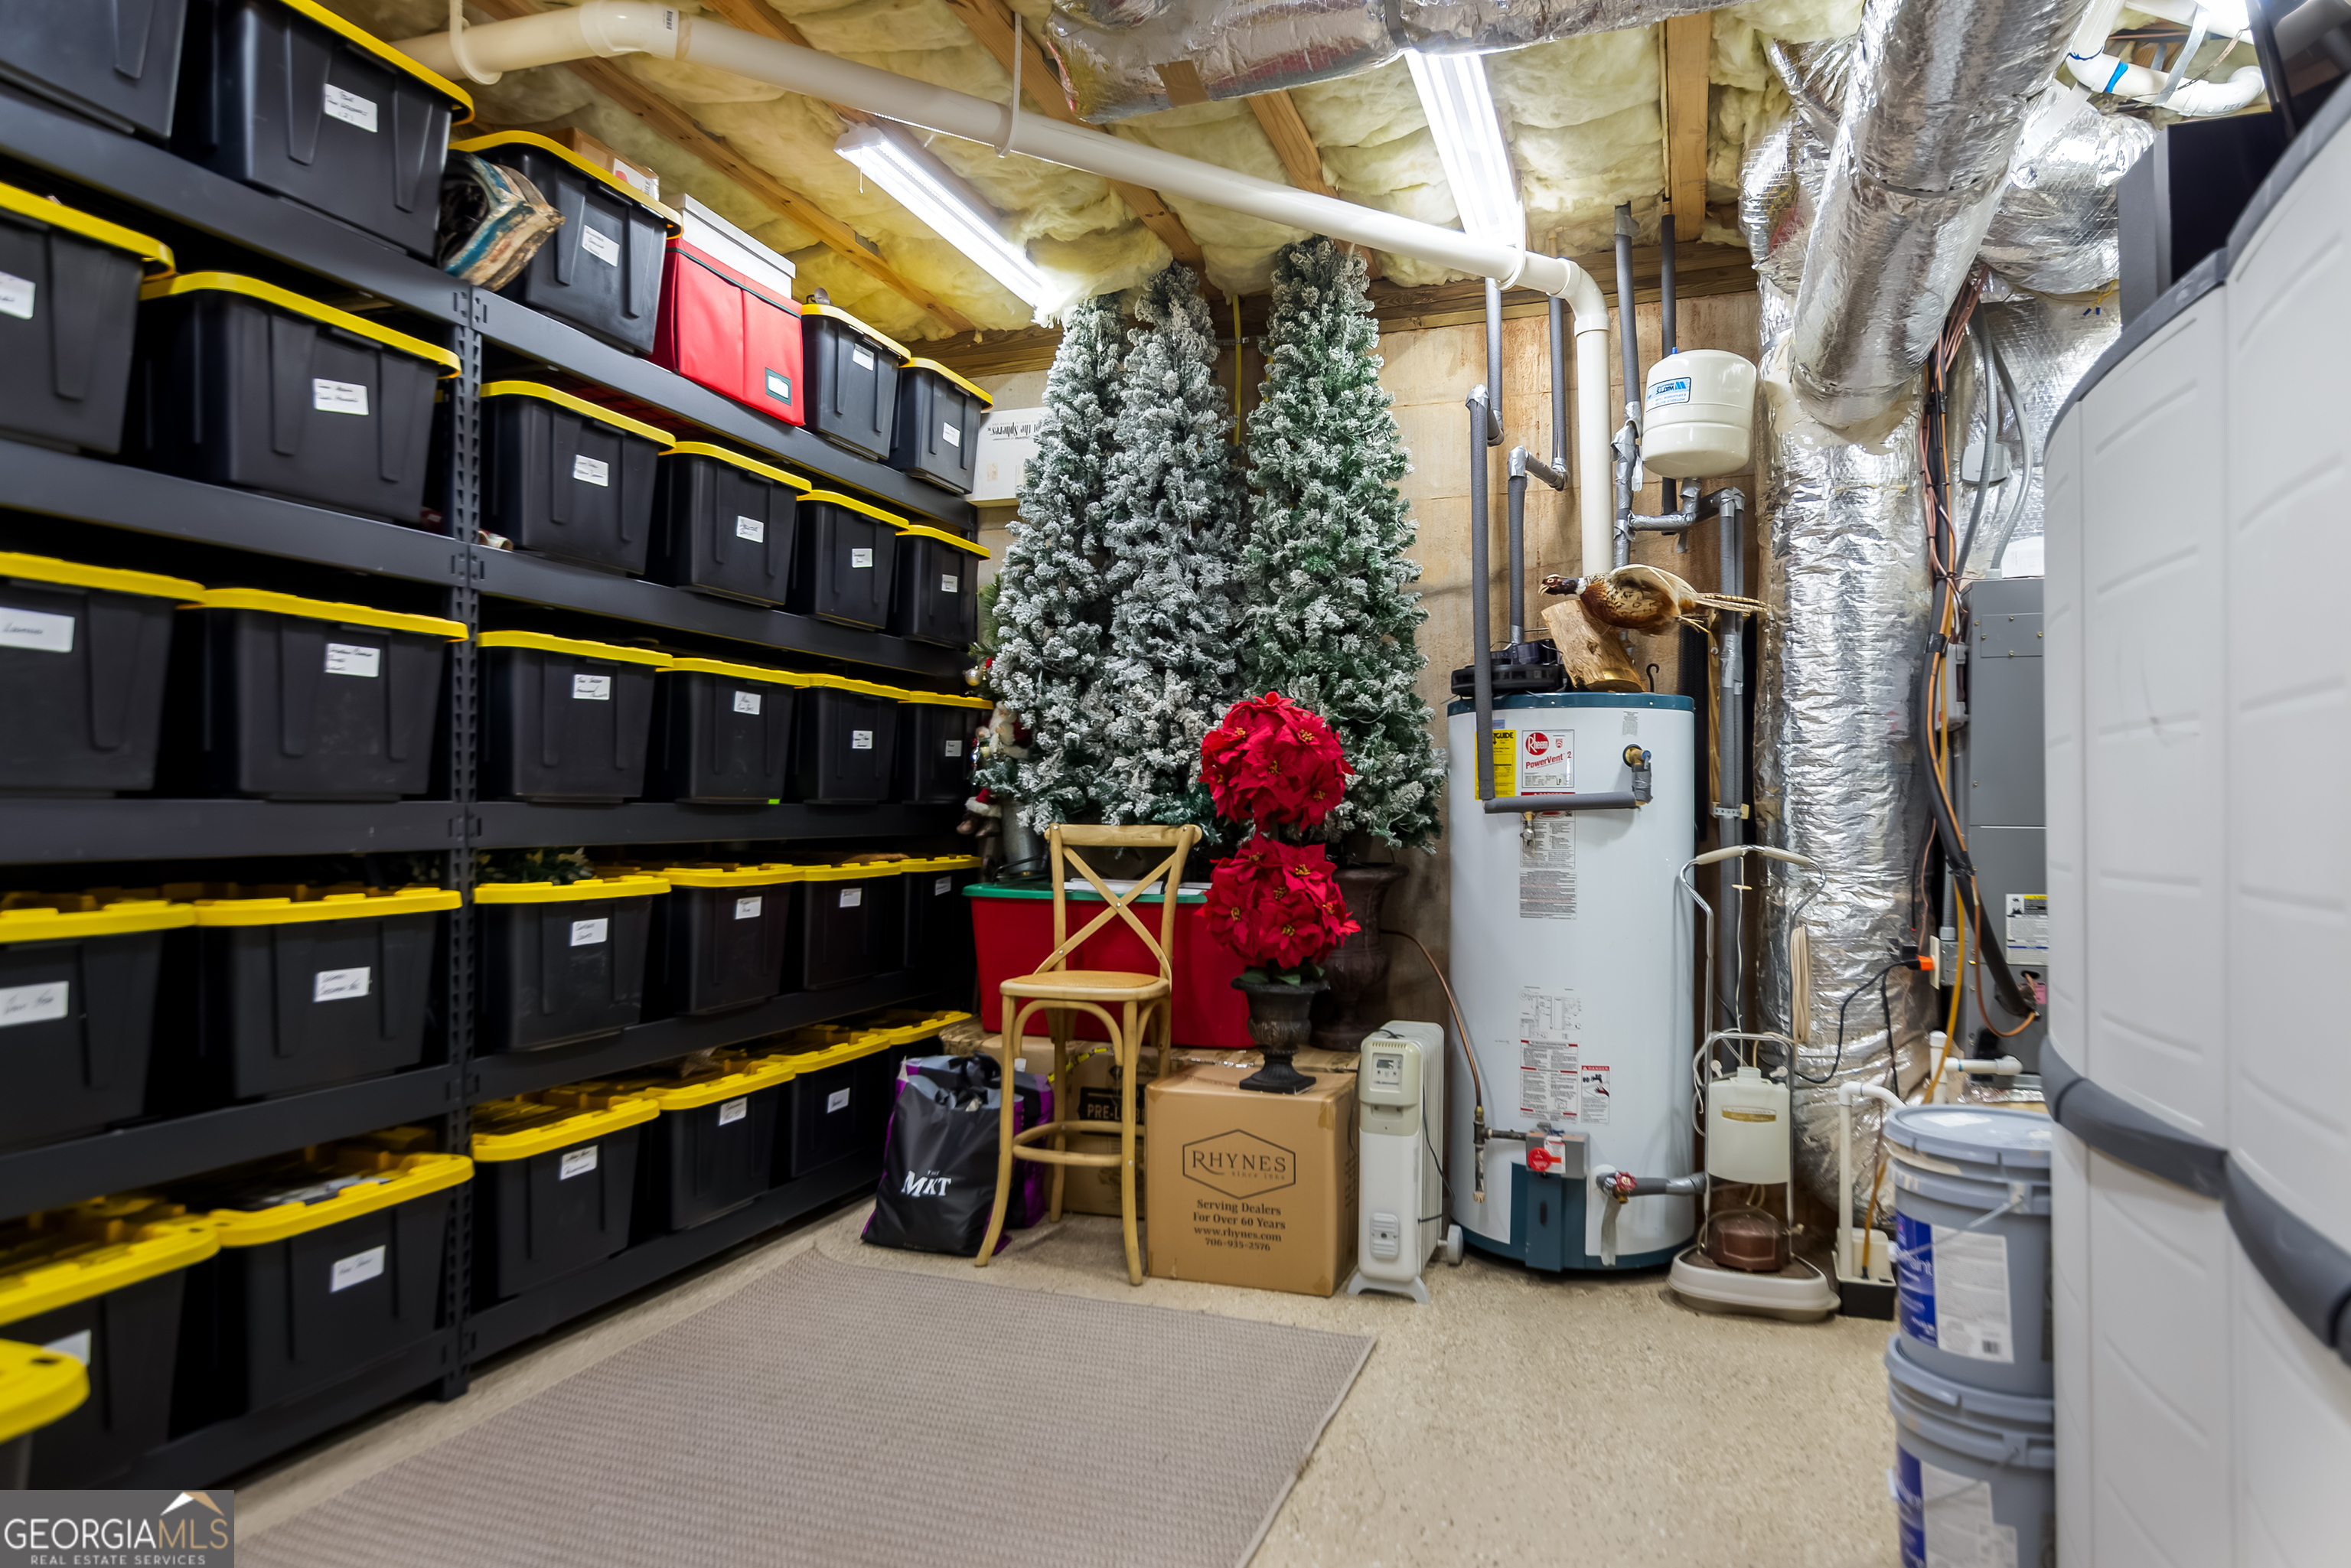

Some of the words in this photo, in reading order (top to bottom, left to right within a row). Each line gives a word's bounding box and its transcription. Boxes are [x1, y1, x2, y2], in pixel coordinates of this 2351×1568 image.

[1020, 425, 1031, 436] the
[1528, 733, 1548, 754] Rheem
[1525, 753, 1564, 769] PowerVent
[1192, 1149, 1286, 1175] RHYNES
[901, 1169, 952, 1198] MKT
[1197, 1198, 1238, 1214] Serving
[1241, 1202, 1282, 1216] Dealers
[1193, 1211, 1210, 1222] For
[1213, 1213, 1238, 1225] Over
[1241, 1216, 1254, 1227] 60
[1257, 1217, 1286, 1230] Years
[1194, 1226, 1282, 1242] www.rhynes.com
